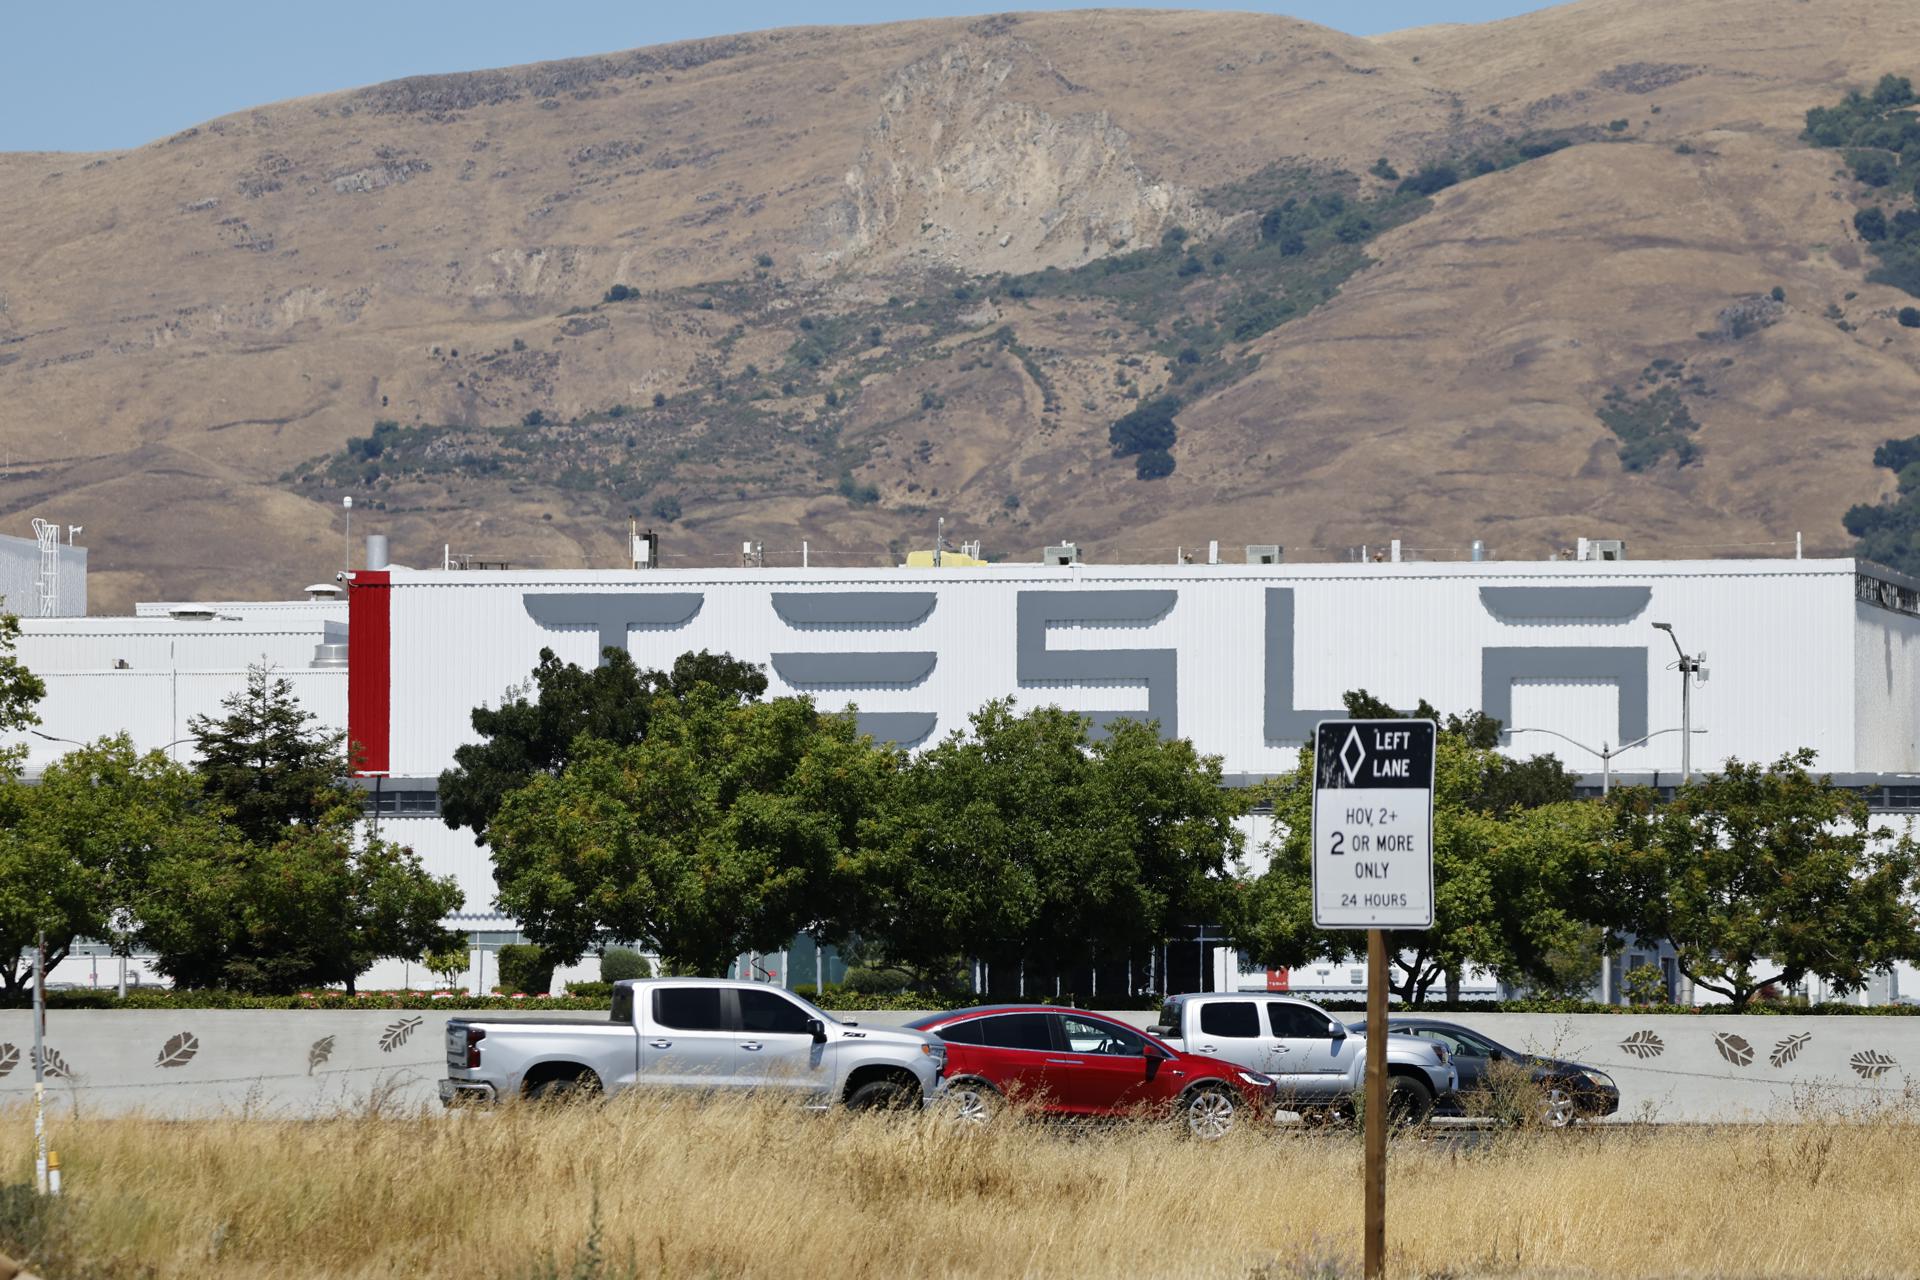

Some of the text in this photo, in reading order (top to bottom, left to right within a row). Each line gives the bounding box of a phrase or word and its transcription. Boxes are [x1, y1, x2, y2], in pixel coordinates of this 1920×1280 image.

[522, 586, 1652, 749] TESLA
[1375, 731, 1410, 750] LEFT
[1373, 759, 1410, 777] LANE
[1379, 808, 1398, 825] 2+
[1330, 831, 1414, 855] 2 OR MORE
[1355, 862, 1390, 879] ONLY
[1341, 893, 1407, 907] 24 HOURS
